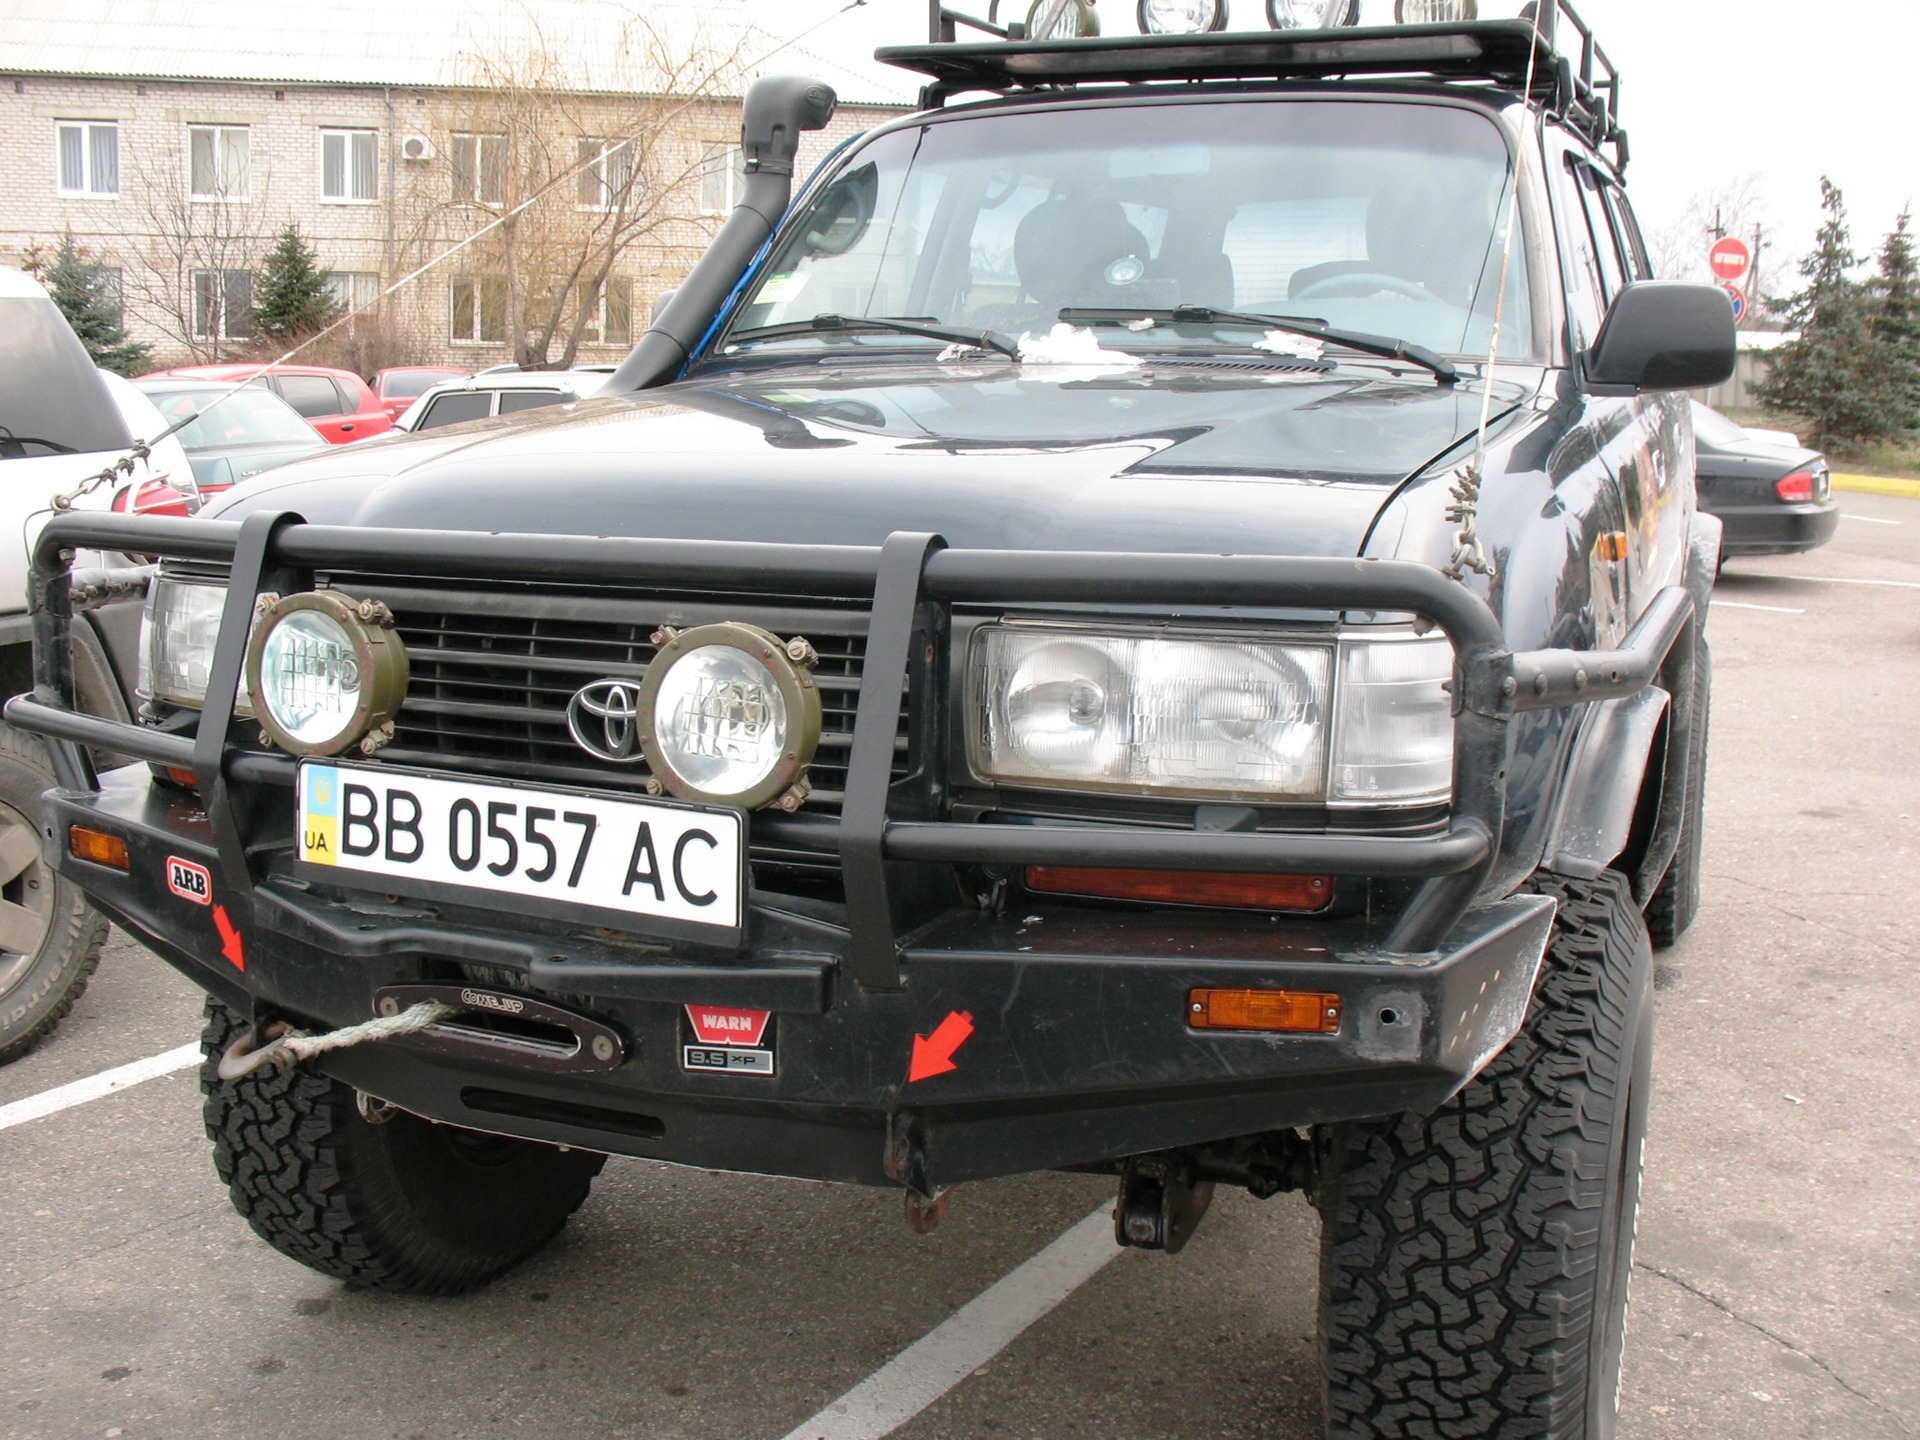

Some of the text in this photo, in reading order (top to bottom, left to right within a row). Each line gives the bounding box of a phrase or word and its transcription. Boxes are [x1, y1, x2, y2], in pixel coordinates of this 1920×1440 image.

[305, 831, 328, 852] UA
[342, 783, 719, 906] BB 0557 AC
[173, 865, 206, 896] ARB
[702, 1014, 752, 1031] WARN
[690, 1051, 756, 1066] 9.5 XP
